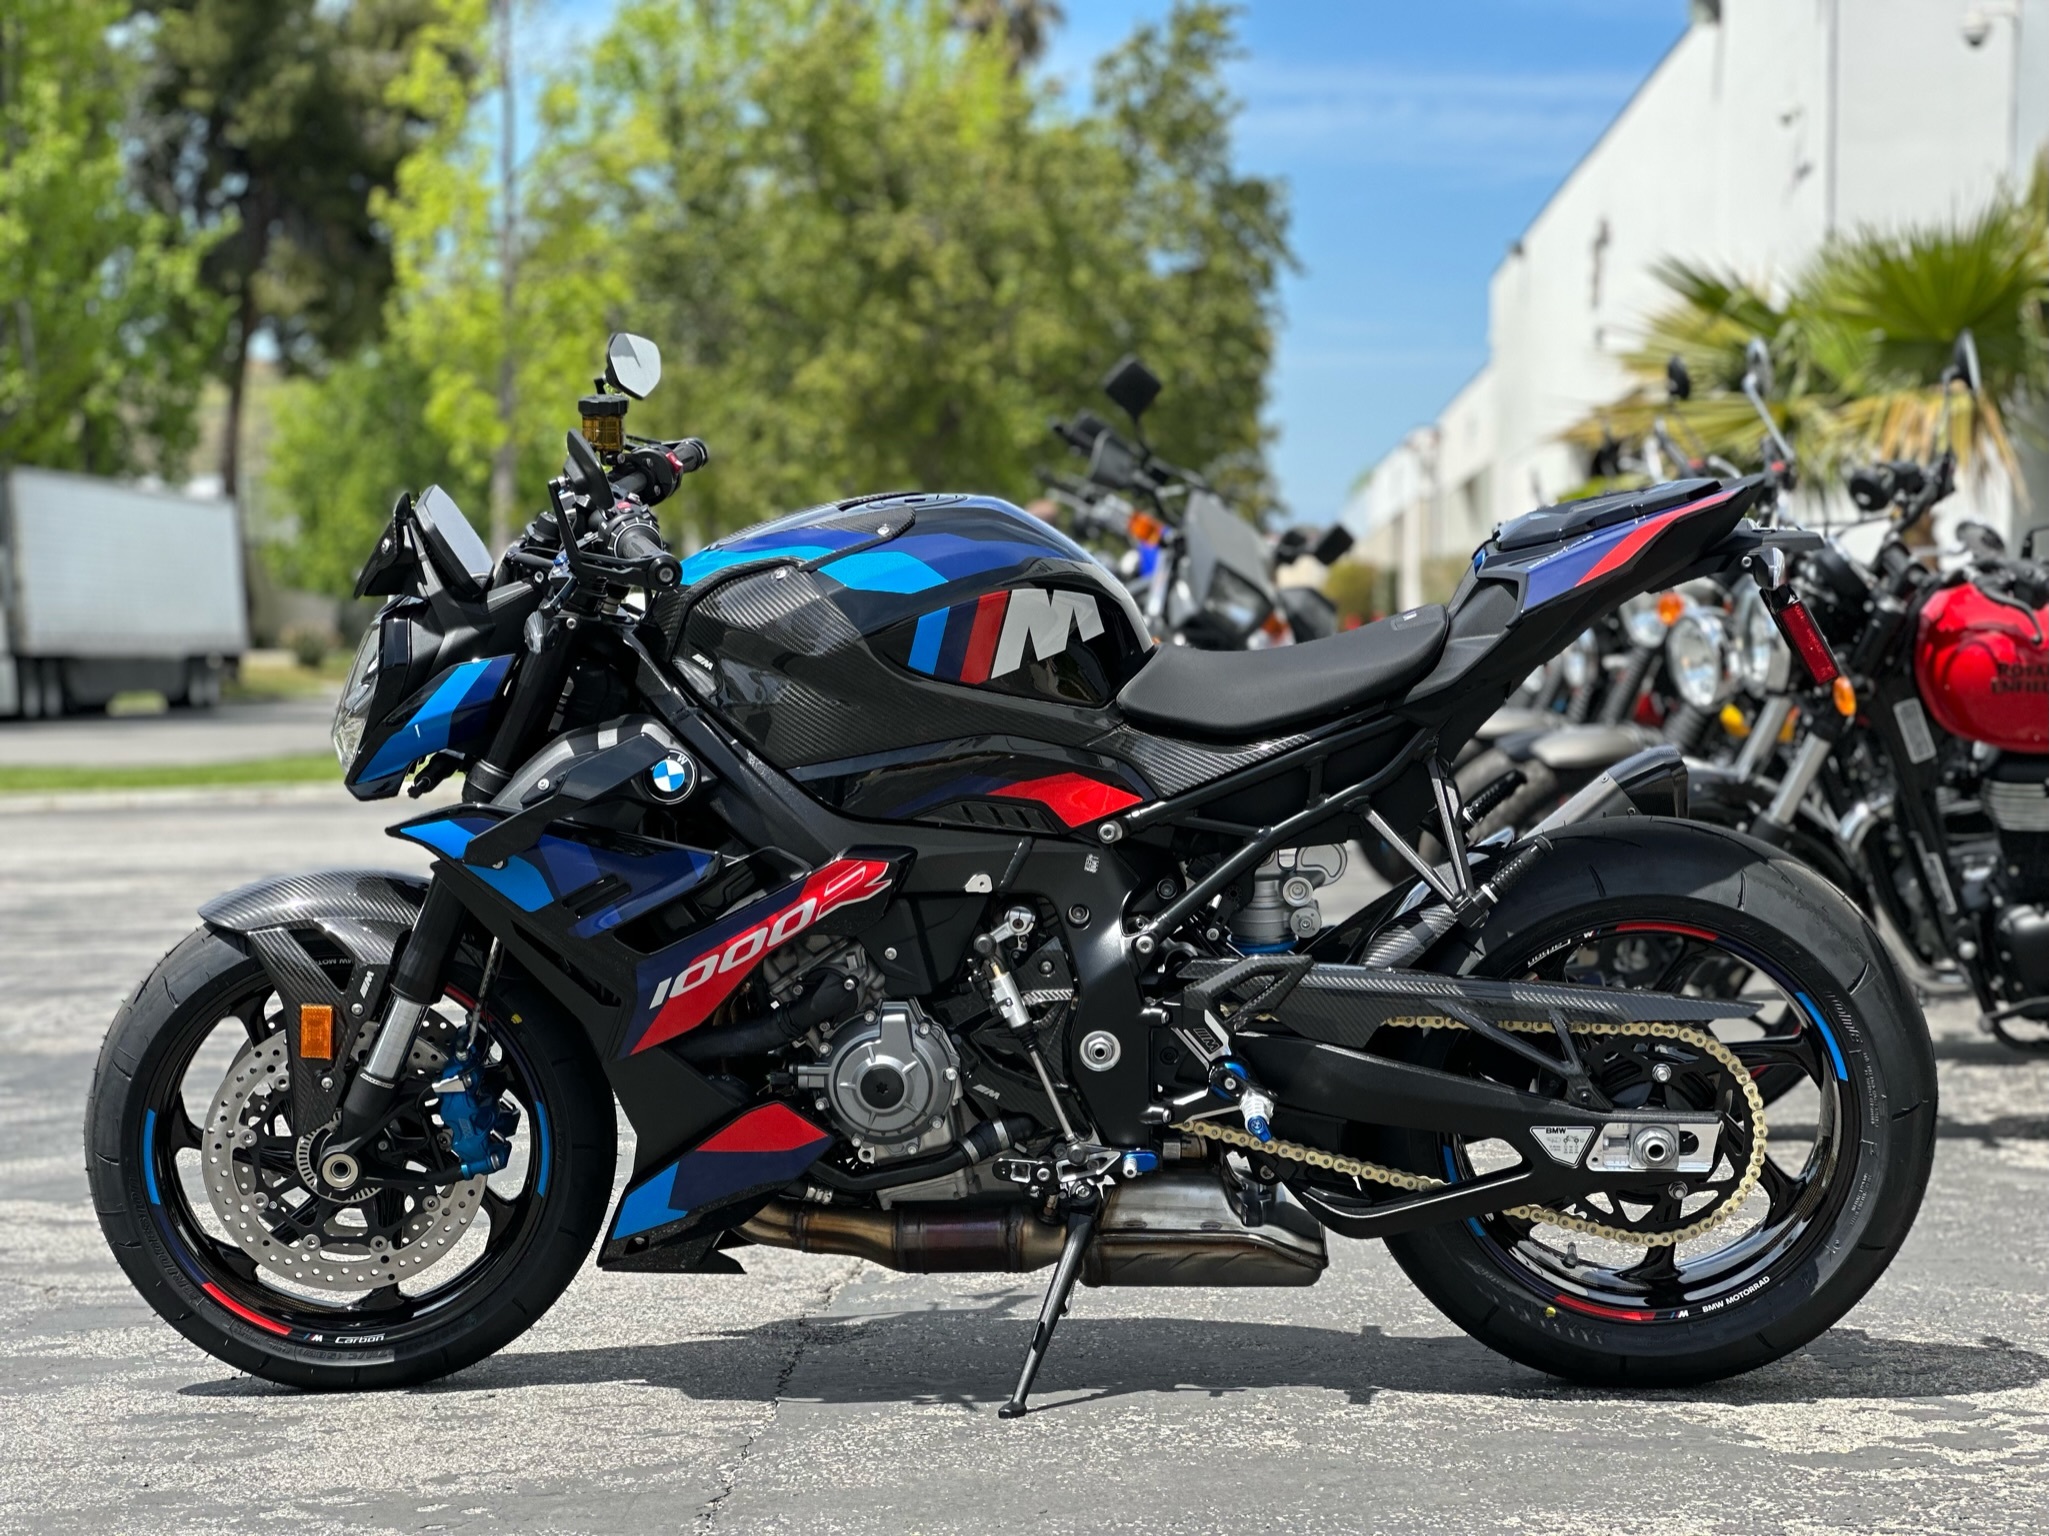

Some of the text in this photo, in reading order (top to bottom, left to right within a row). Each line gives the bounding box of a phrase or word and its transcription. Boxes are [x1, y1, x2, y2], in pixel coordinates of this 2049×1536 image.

[991, 588, 1105, 680] M
[1997, 661, 2049, 677] ROYA
[1545, 1127, 1567, 1135] BMW
[1702, 1275, 1771, 1313] BMW MOTORRAD
[335, 1333, 386, 1344] Carbon
